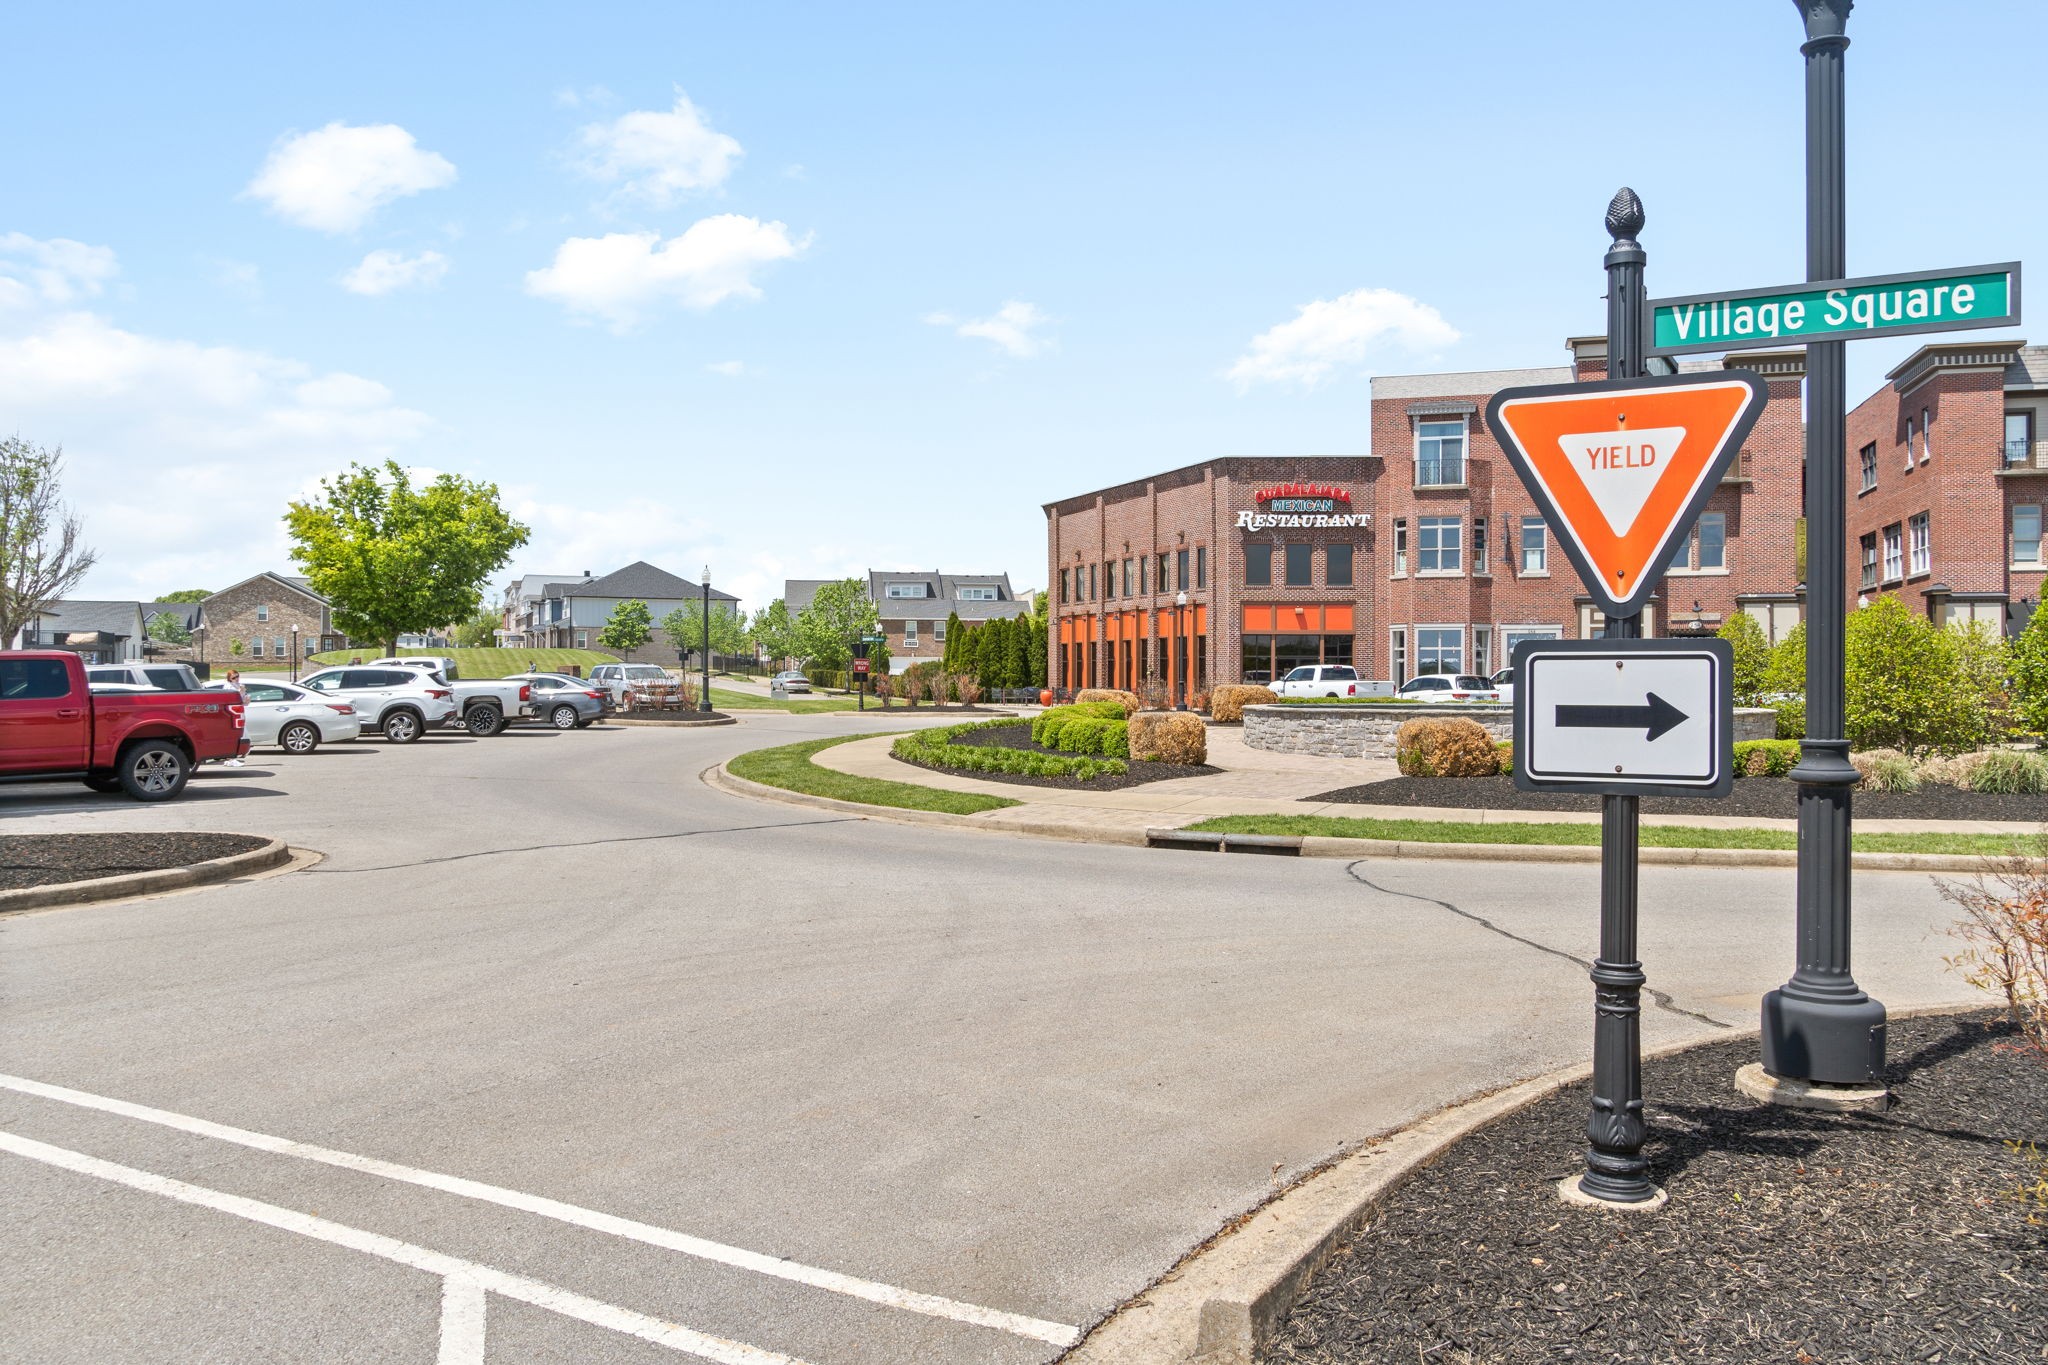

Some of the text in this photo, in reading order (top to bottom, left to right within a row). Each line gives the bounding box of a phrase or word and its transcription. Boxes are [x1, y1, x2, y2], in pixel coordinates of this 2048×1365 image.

[1672, 282, 1976, 340] Village Square
[1586, 443, 1656, 470] YIELD
[1255, 483, 1351, 503] GUADALAJARA
[1271, 499, 1334, 512] MEXICAN
